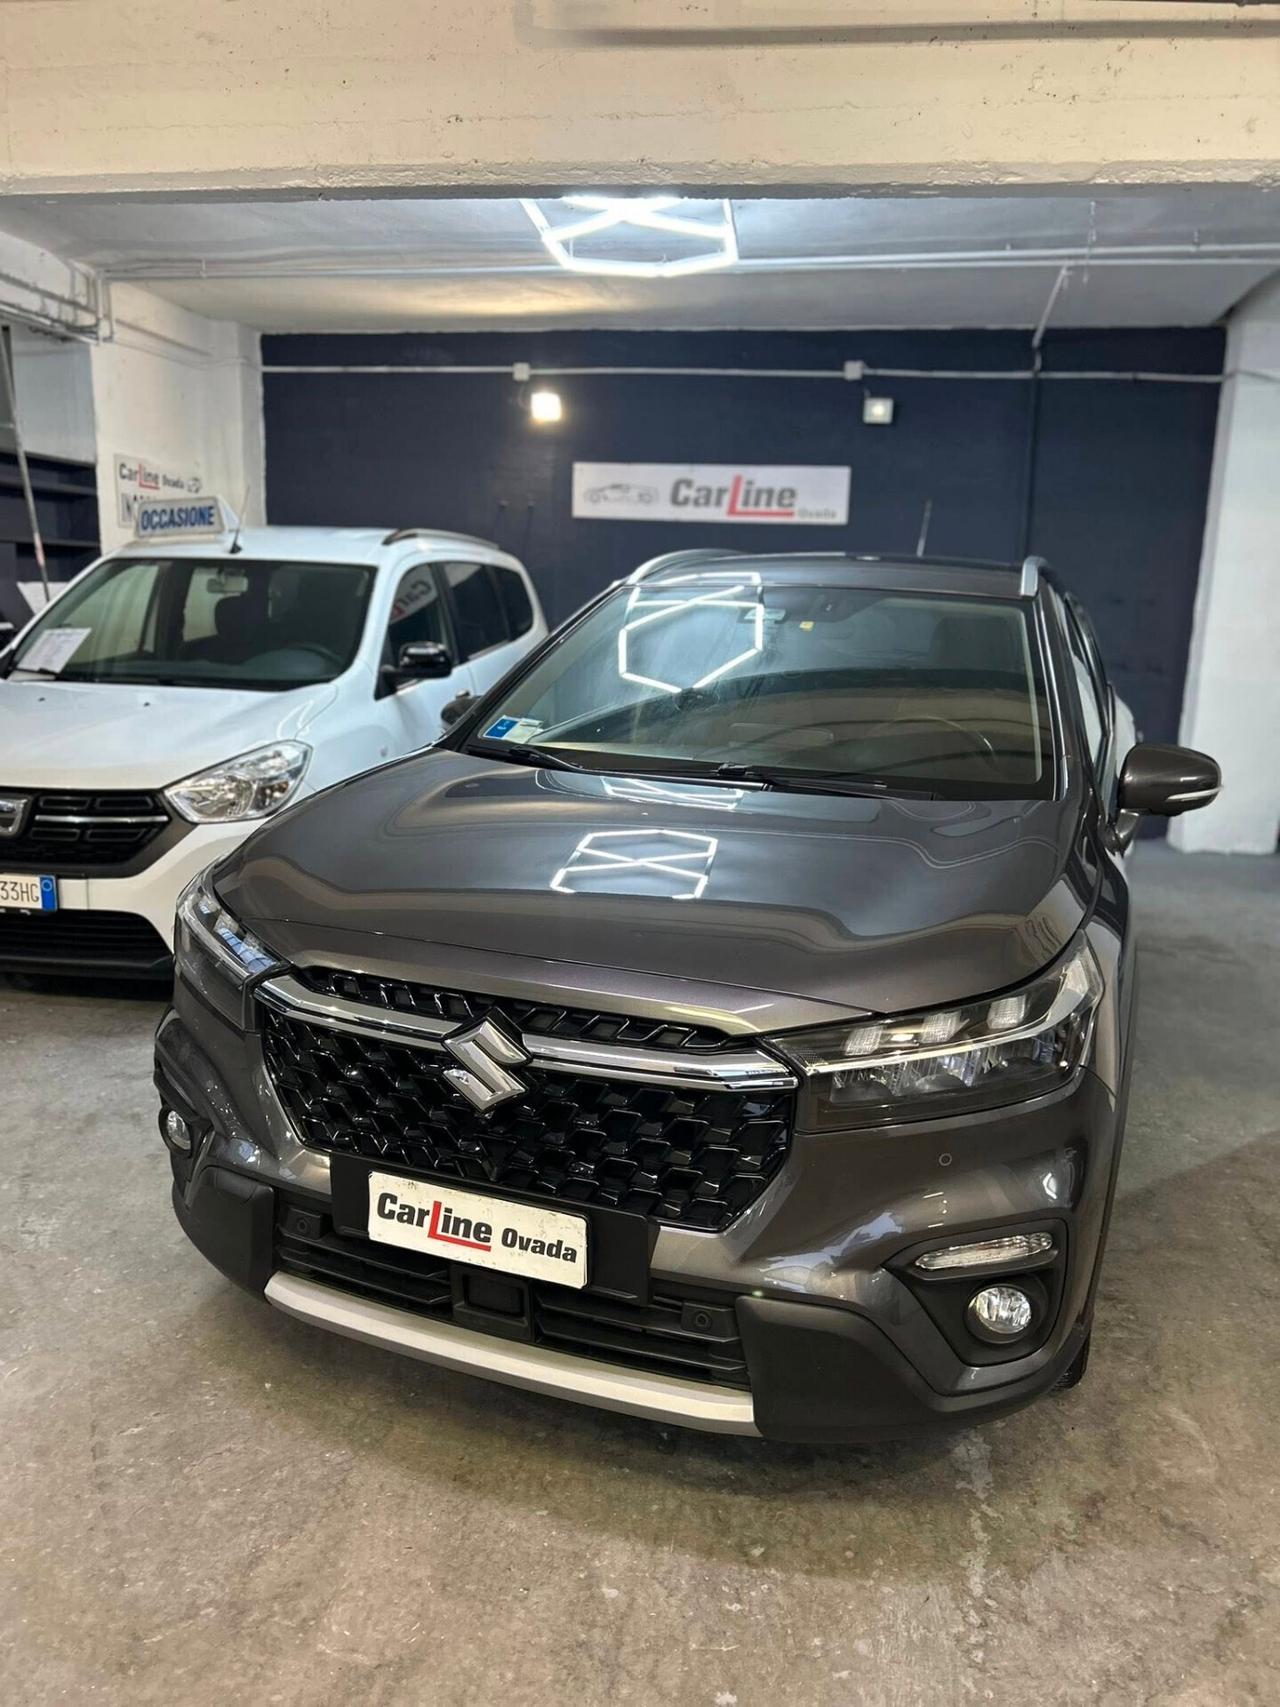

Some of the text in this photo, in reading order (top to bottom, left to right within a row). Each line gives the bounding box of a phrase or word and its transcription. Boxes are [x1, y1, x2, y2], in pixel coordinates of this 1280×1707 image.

[119, 463, 160, 490] CarLine
[669, 474, 797, 518] CarLine
[140, 505, 215, 531] OCCASIONE
[377, 1192, 578, 1263] CarLine Ovada
